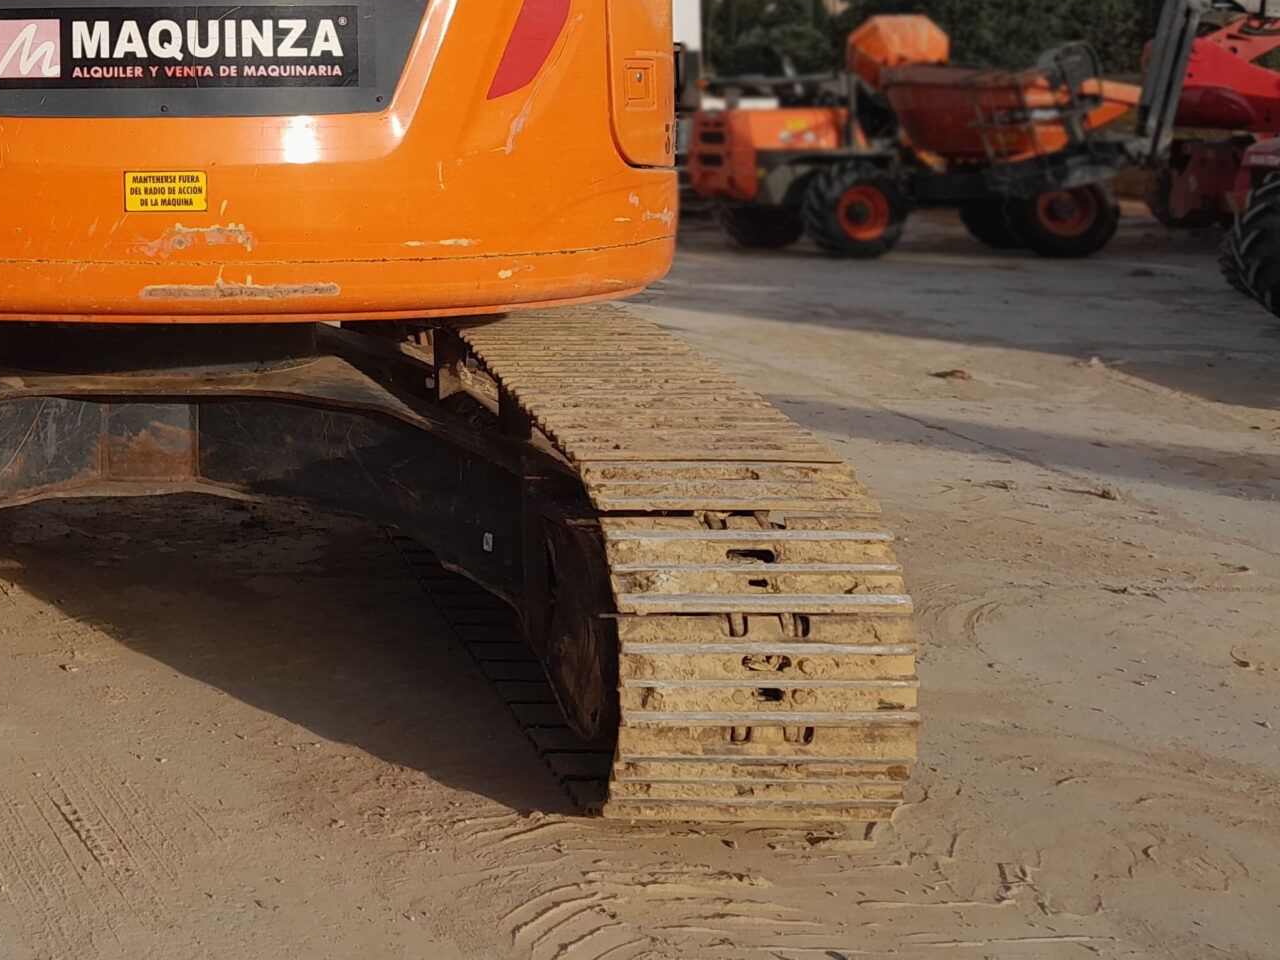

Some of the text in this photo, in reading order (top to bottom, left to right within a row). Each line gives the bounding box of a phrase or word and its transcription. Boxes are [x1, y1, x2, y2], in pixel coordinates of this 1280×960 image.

[72, 19, 344, 61] MAQUINZA
[72, 65, 343, 78] ALQUILER Y VENTA DE MAQUINARIA
[132, 175, 200, 184] MANTENERSE FUERA
[130, 187, 142, 195] DEL
[144, 187, 166, 195] RADIO
[167, 187, 177, 195] DE
[140, 198, 148, 207] DE
[150, 198, 159, 206] LA
